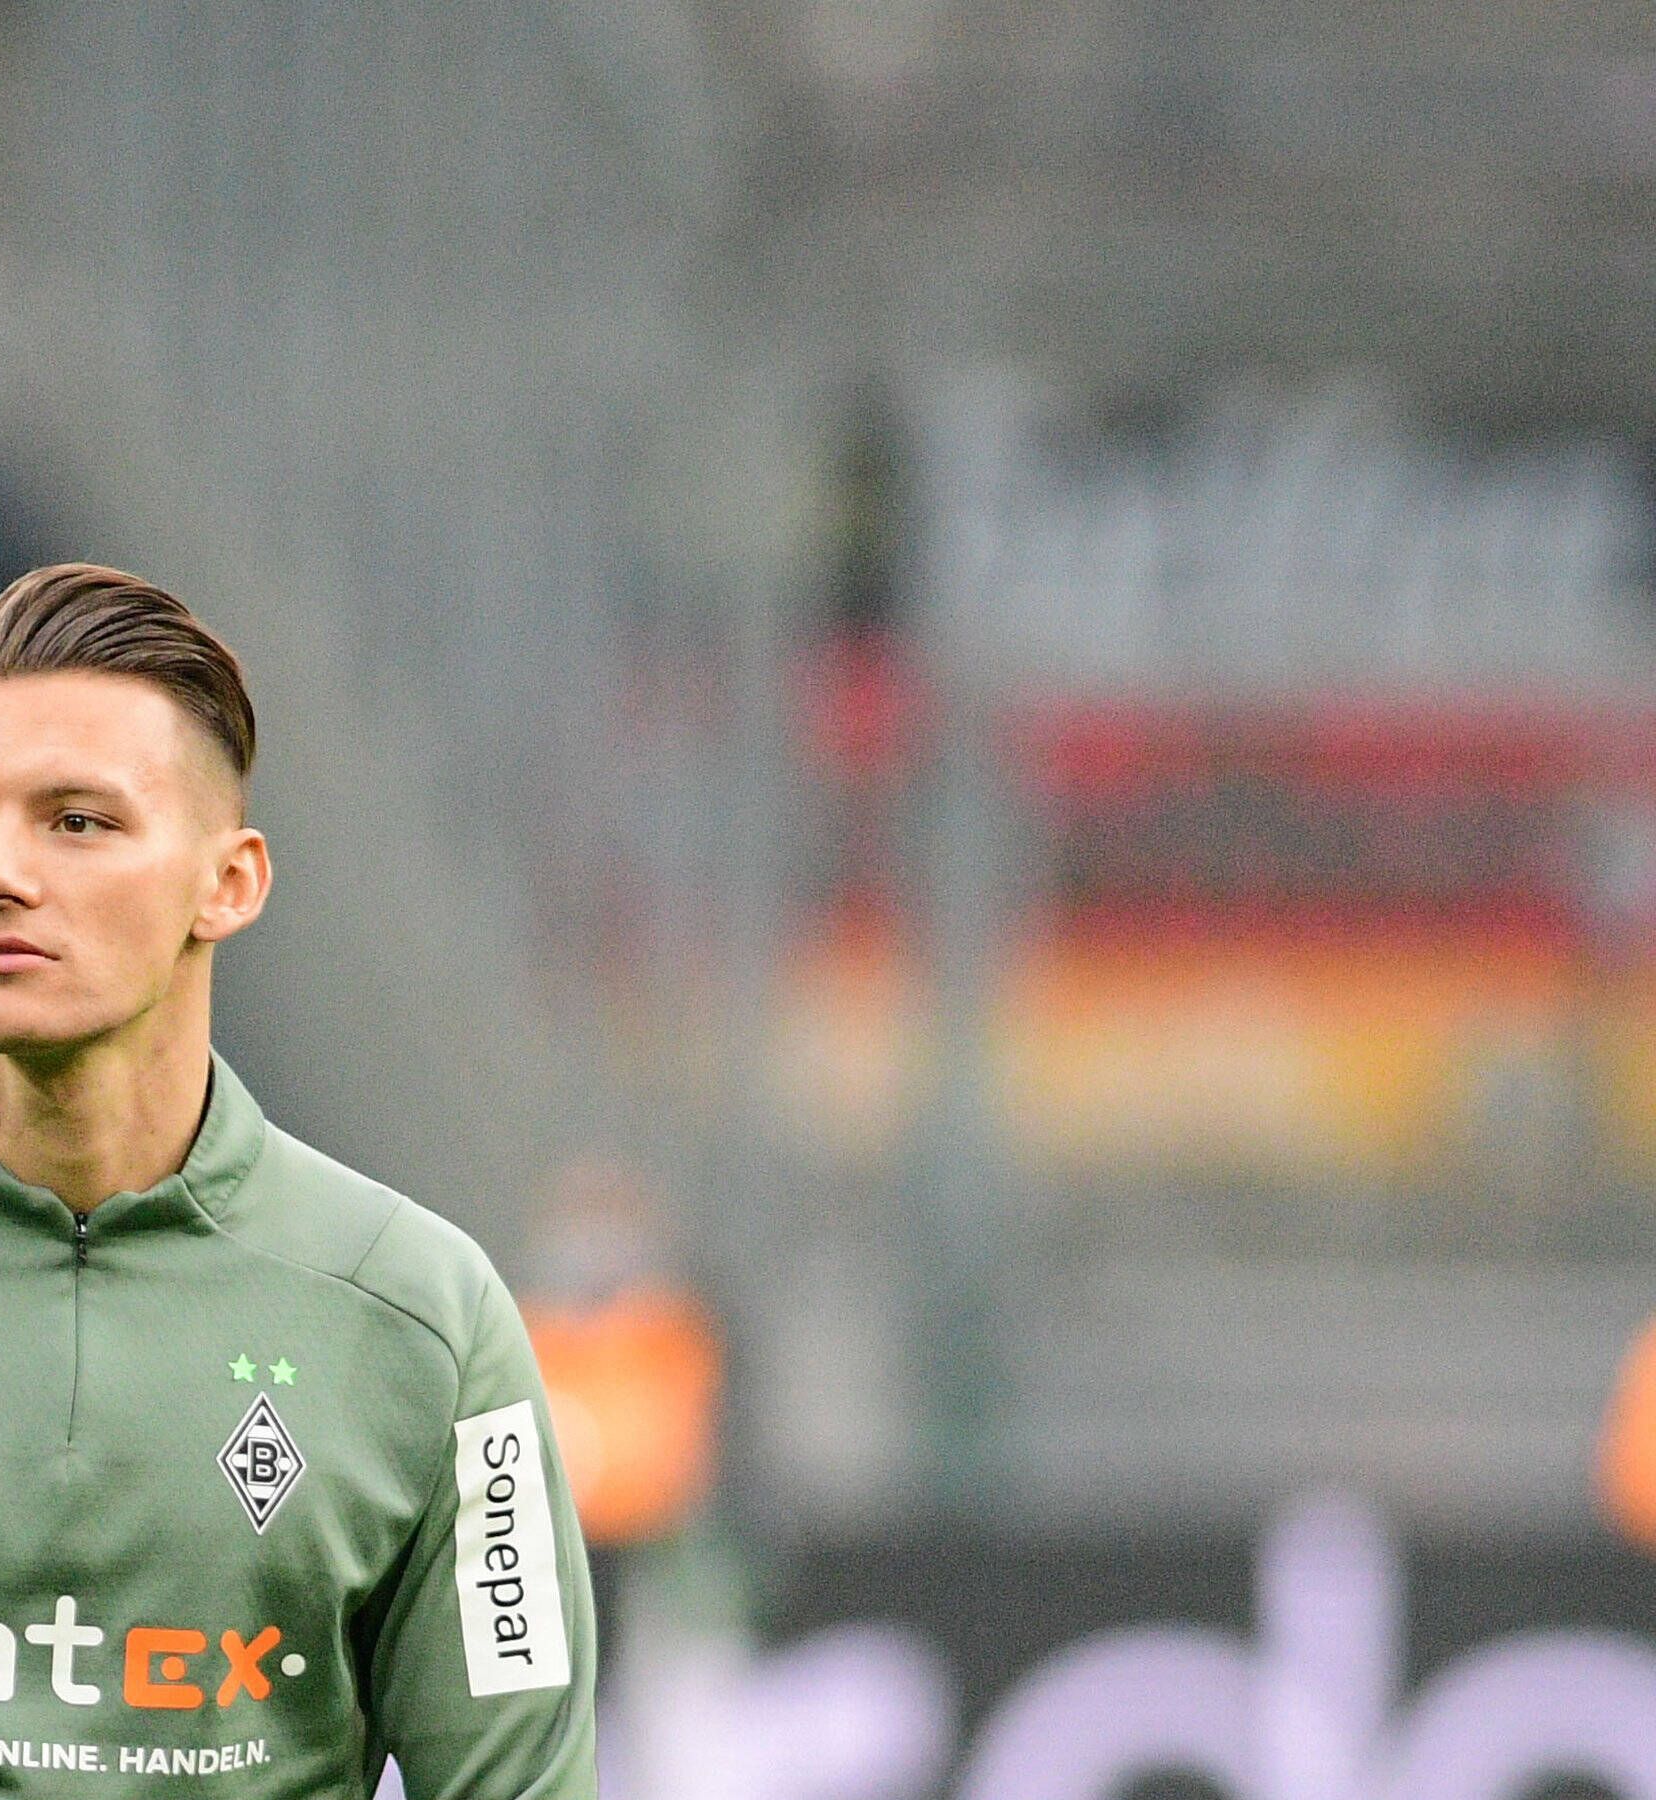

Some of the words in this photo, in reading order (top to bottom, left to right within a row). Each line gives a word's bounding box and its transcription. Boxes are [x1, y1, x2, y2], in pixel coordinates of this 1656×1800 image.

[247, 1438, 282, 1486] B
[476, 1432, 533, 1666] Sonepar
[119, 1739, 271, 1775] HANDELN.
